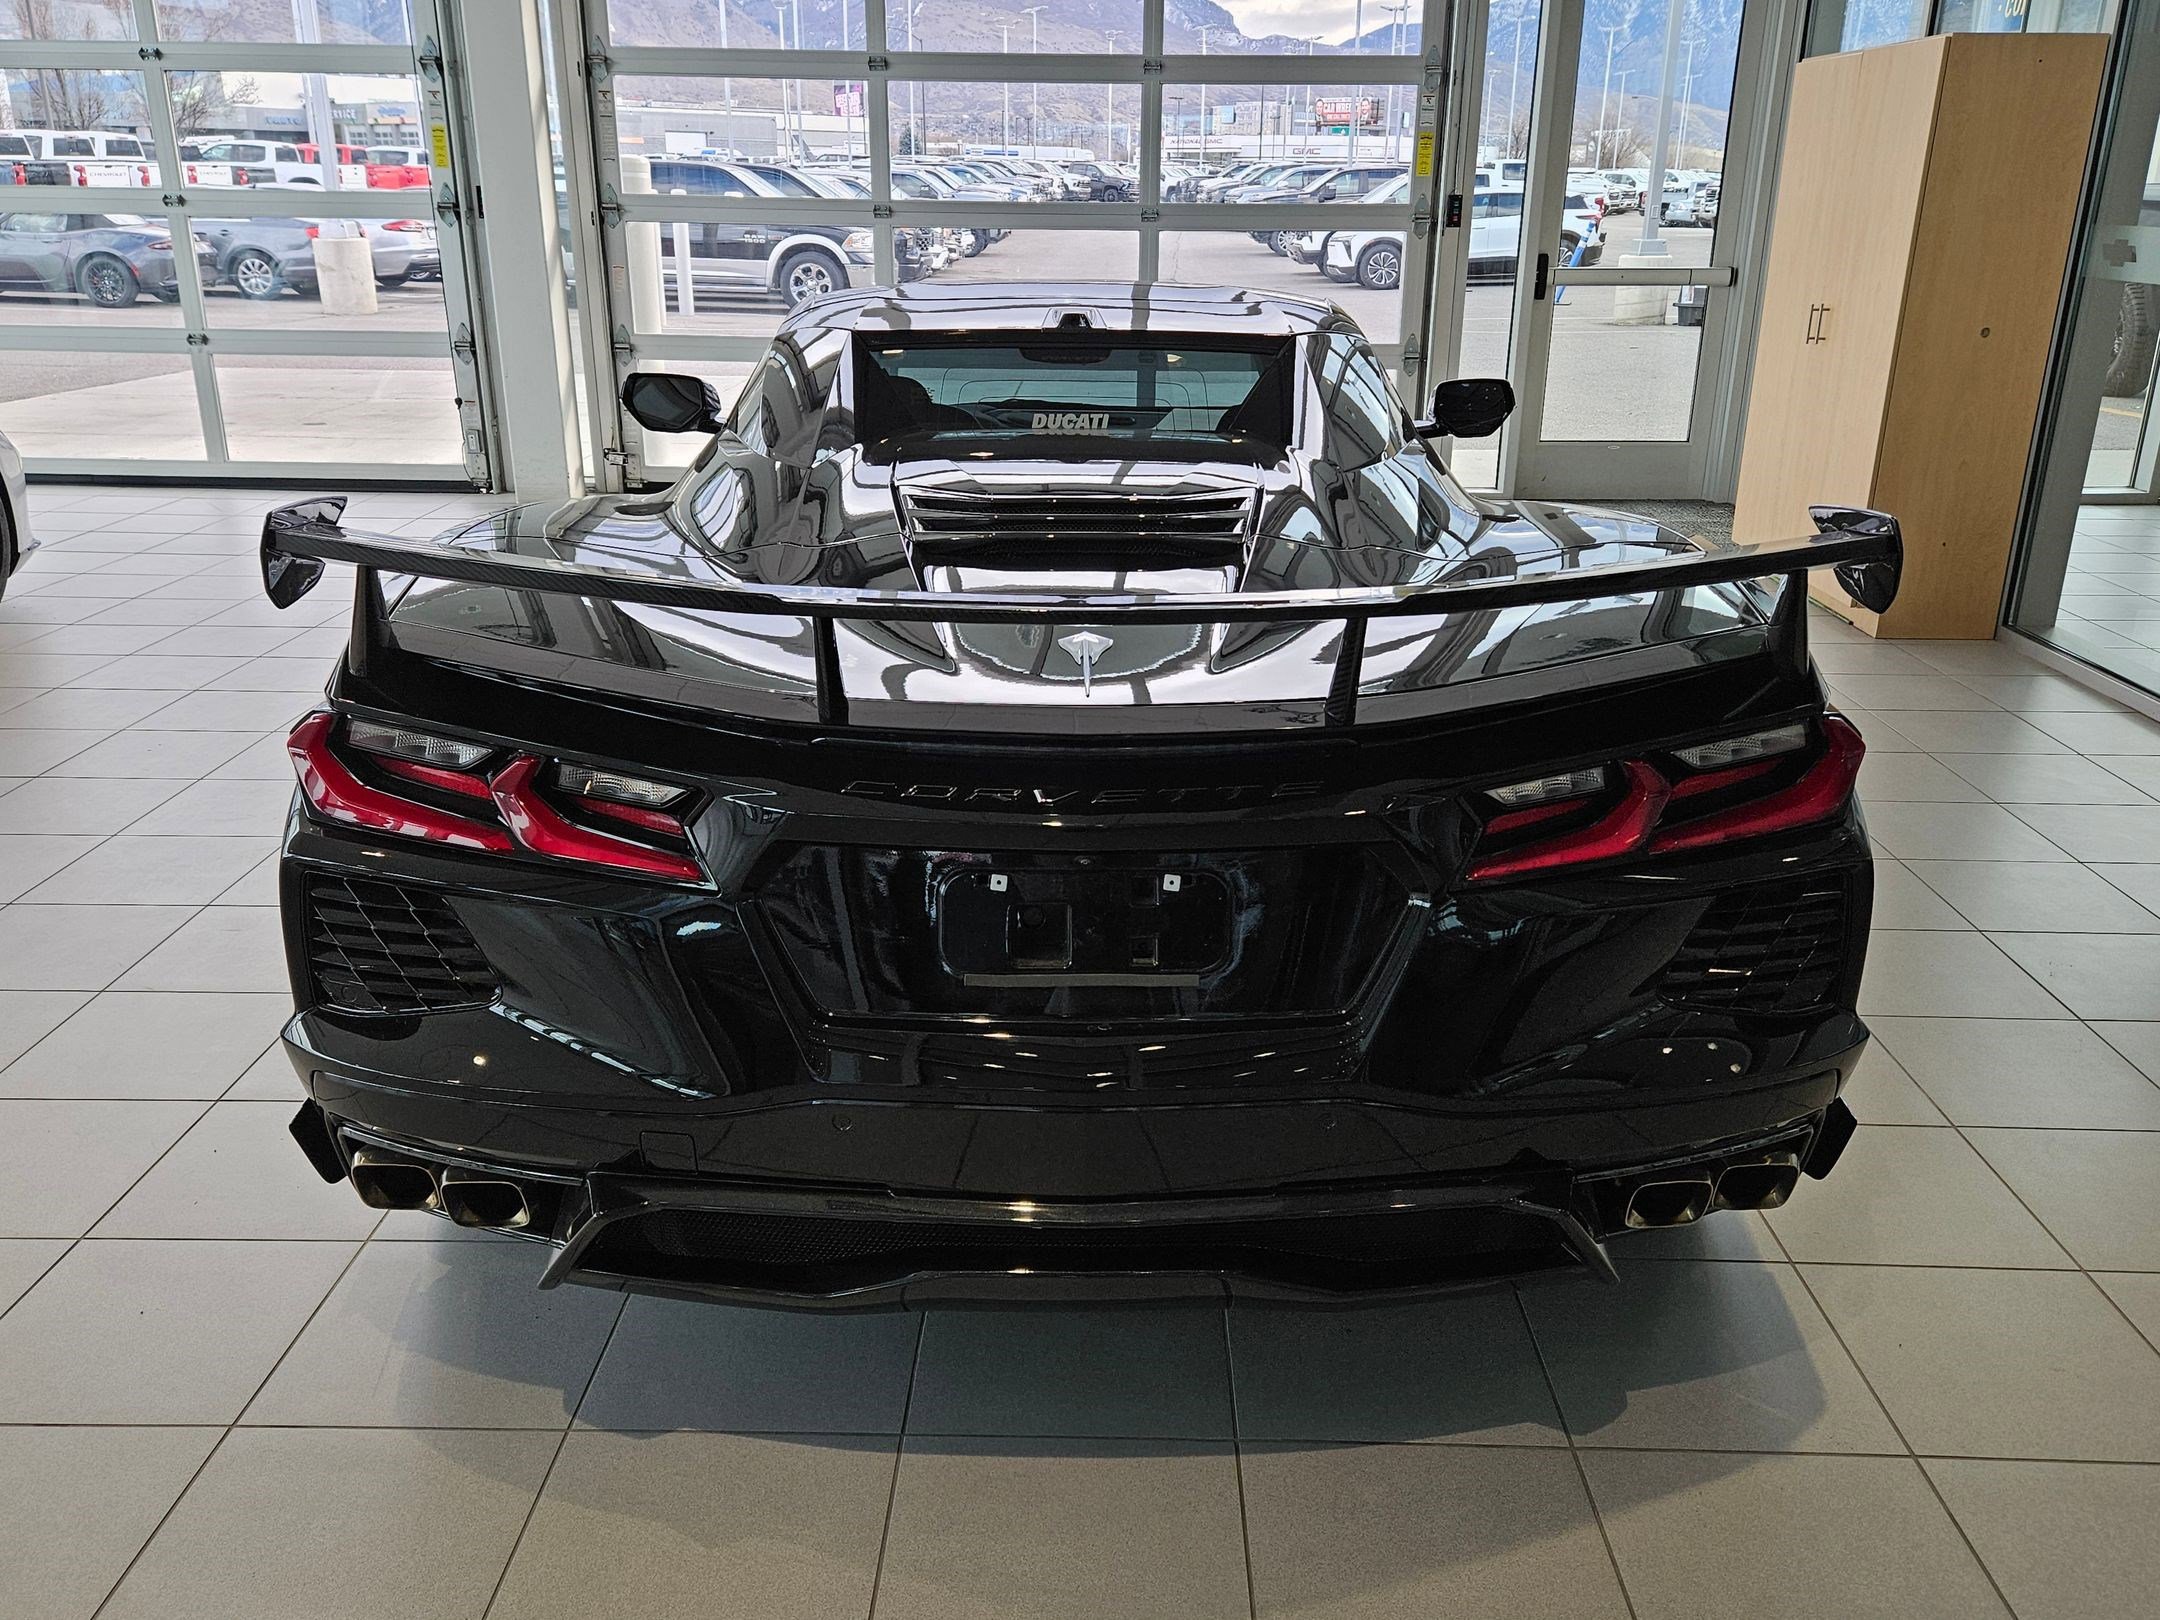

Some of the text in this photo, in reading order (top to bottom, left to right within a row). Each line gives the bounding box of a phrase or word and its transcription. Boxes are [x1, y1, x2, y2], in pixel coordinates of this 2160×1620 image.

[1292, 147, 1321, 155] GMC
[1031, 413, 1110, 429] DUCATI
[840, 781, 1322, 806] CORVETTE
